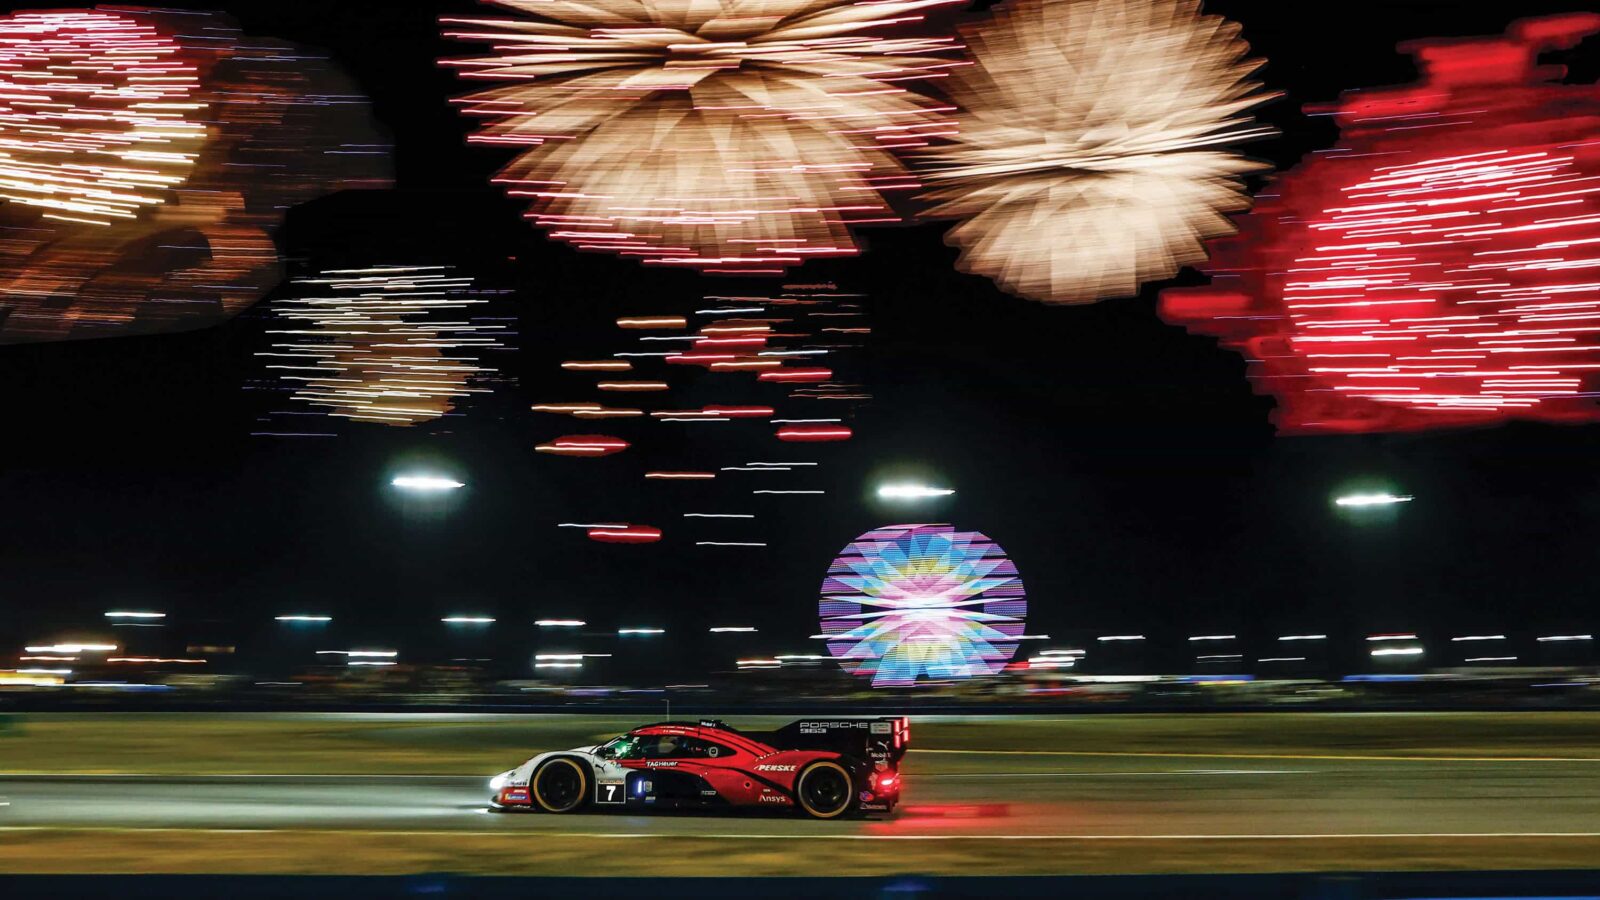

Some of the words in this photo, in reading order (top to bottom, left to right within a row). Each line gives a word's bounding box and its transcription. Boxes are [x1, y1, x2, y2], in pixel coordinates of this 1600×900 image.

[757, 764, 797, 772] PENSKE
[606, 785, 616, 801] 7
[759, 794, 786, 803] Ansys
